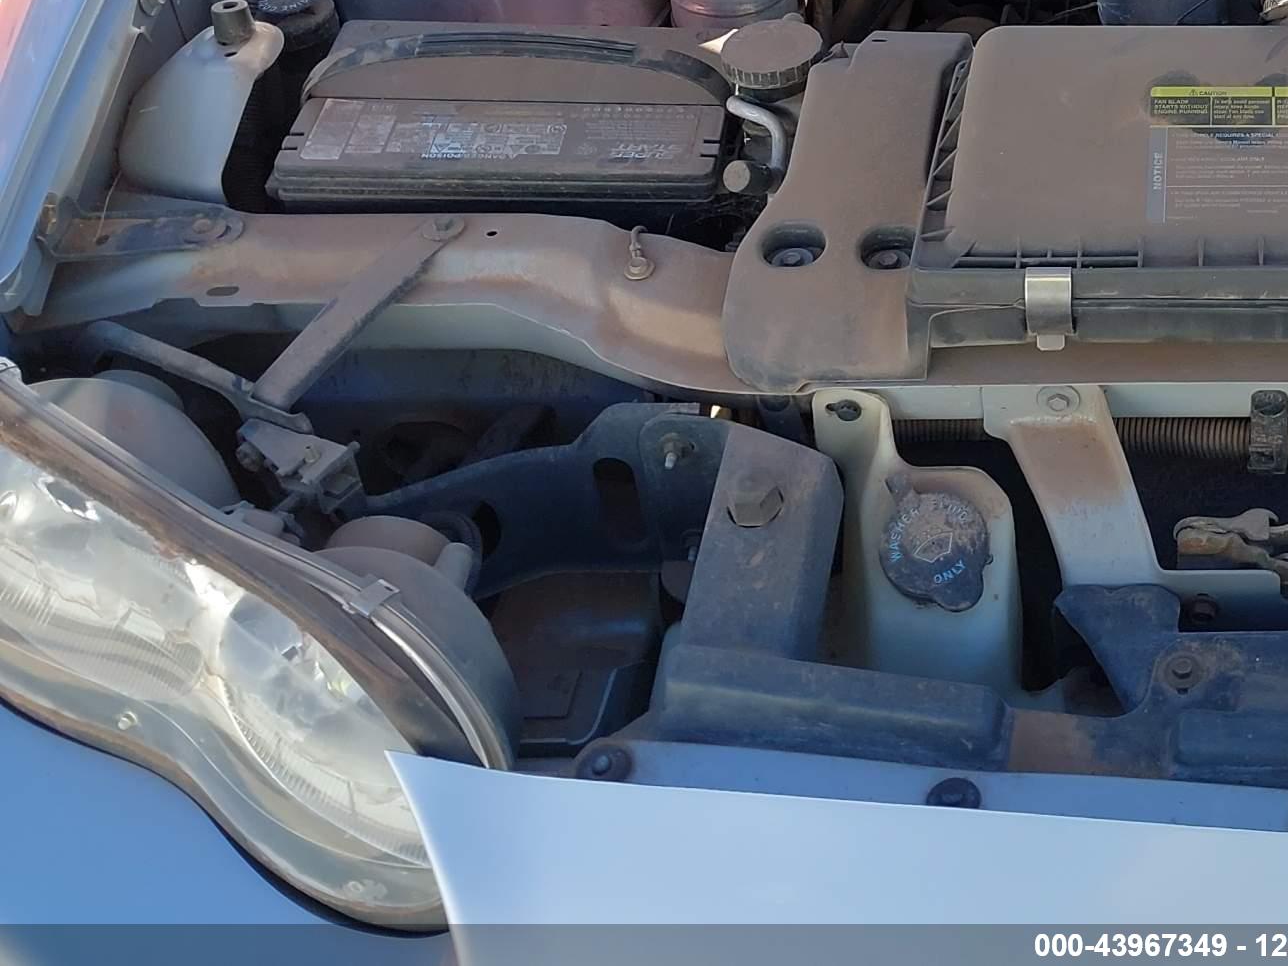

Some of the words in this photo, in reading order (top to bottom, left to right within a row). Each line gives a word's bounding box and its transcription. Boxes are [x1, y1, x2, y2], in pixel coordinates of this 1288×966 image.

[610, 151, 673, 159] SUPER
[1153, 152, 1162, 190] NOTICE
[889, 506, 920, 563] WASHER
[933, 559, 967, 584] ONLY
